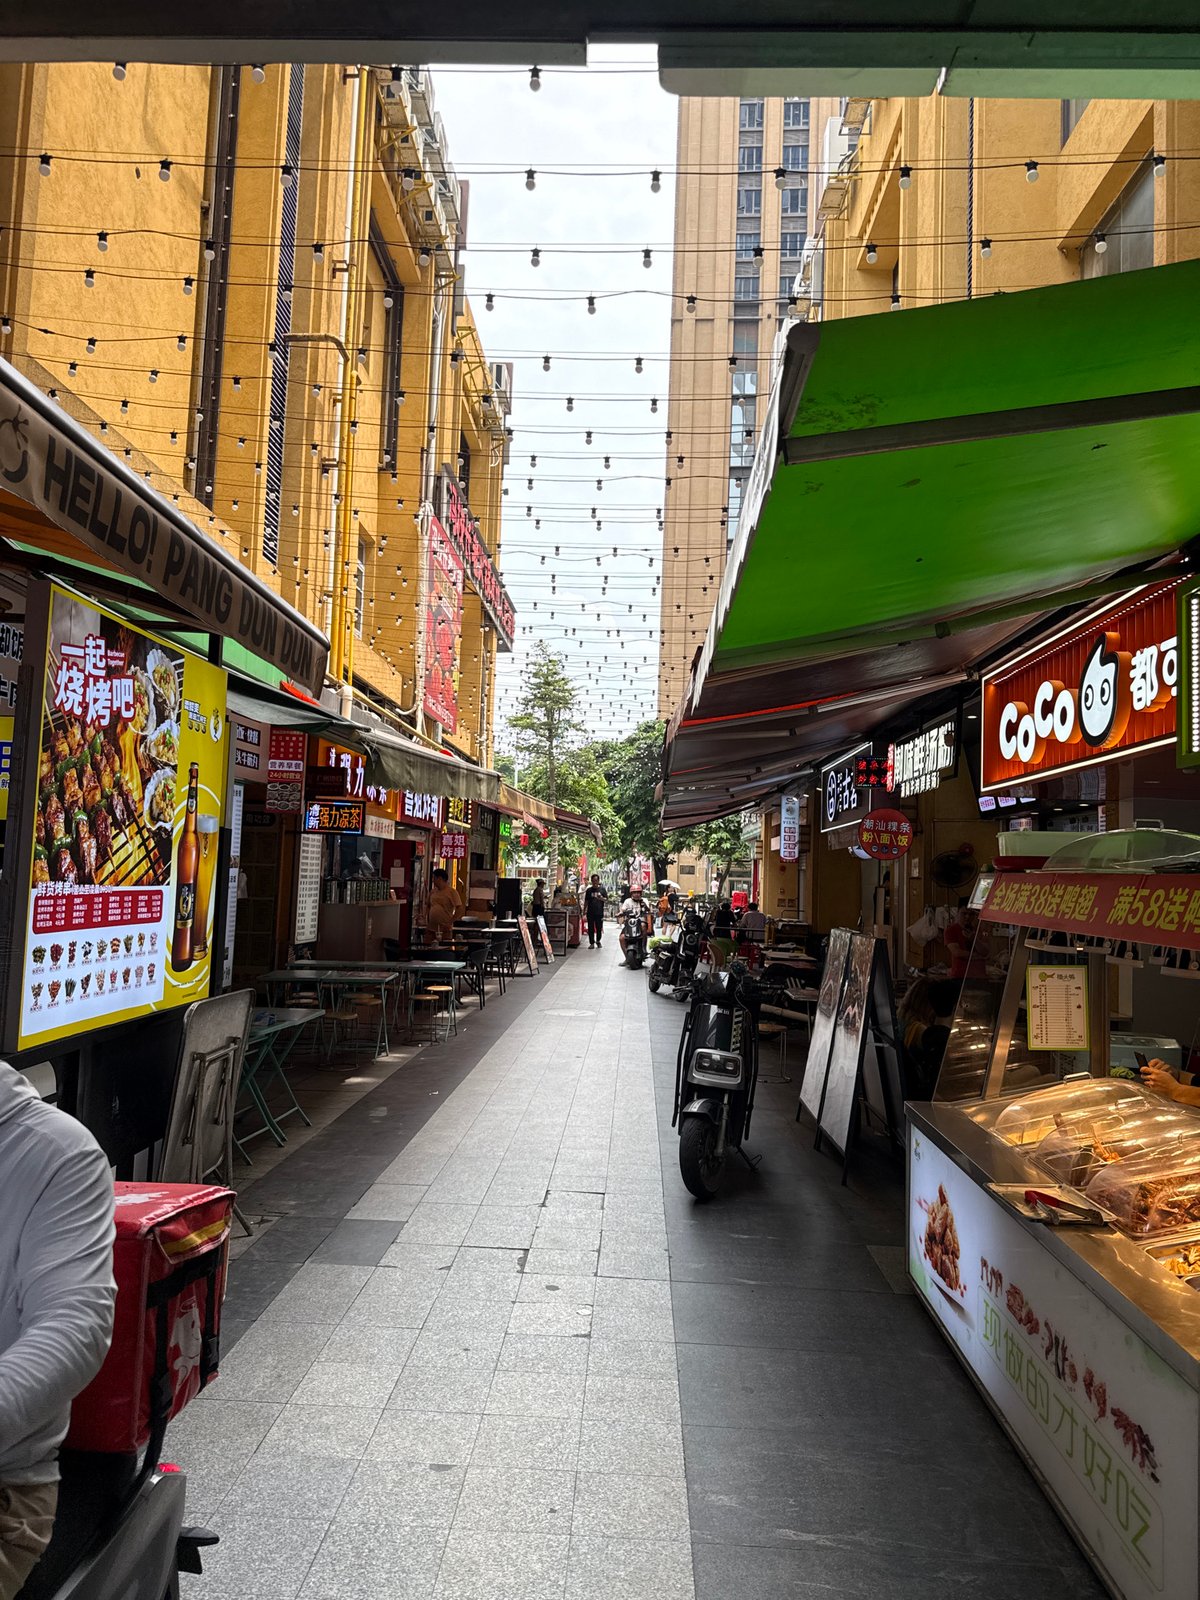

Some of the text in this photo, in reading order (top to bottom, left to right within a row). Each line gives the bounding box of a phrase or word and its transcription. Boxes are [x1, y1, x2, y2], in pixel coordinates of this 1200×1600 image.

[44, 437, 314, 681] HELLO! PANG DUN DUN
[61, 635, 106, 677] 一起
[55, 660, 134, 727] 烧烤吧
[1000, 681, 1075, 763] CoCo
[269, 761, 302, 769] 营养早餐
[319, 806, 361, 828] 强力凉茶
[863, 819, 910, 833] 潮汕粿条
[441, 846, 465, 858] 炸串
[442, 835, 466, 847] 喜姐
[37, 882, 72, 897] 鲜货烤串
[983, 1298, 1152, 1569] 现做的才好吃
